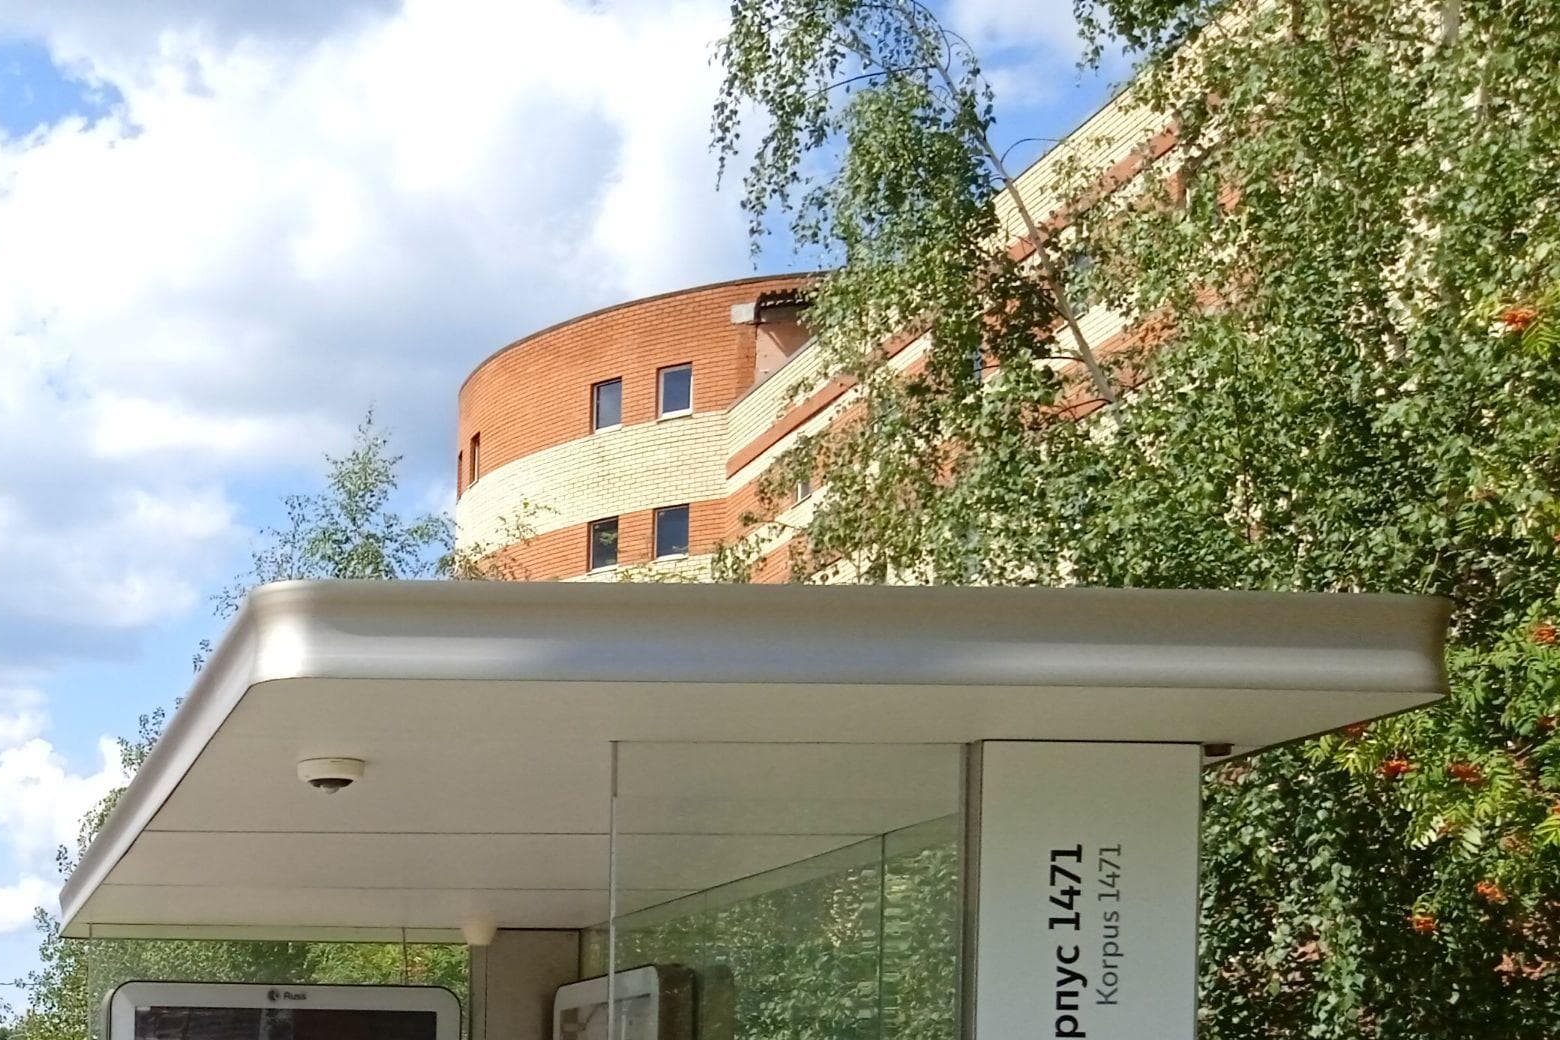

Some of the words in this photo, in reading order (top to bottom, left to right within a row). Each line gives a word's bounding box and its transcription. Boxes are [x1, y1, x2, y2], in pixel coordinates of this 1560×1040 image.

[1048, 843, 1083, 931] 1471
[1098, 843, 1122, 902] 1471
[1096, 910, 1124, 1005] Korpus
